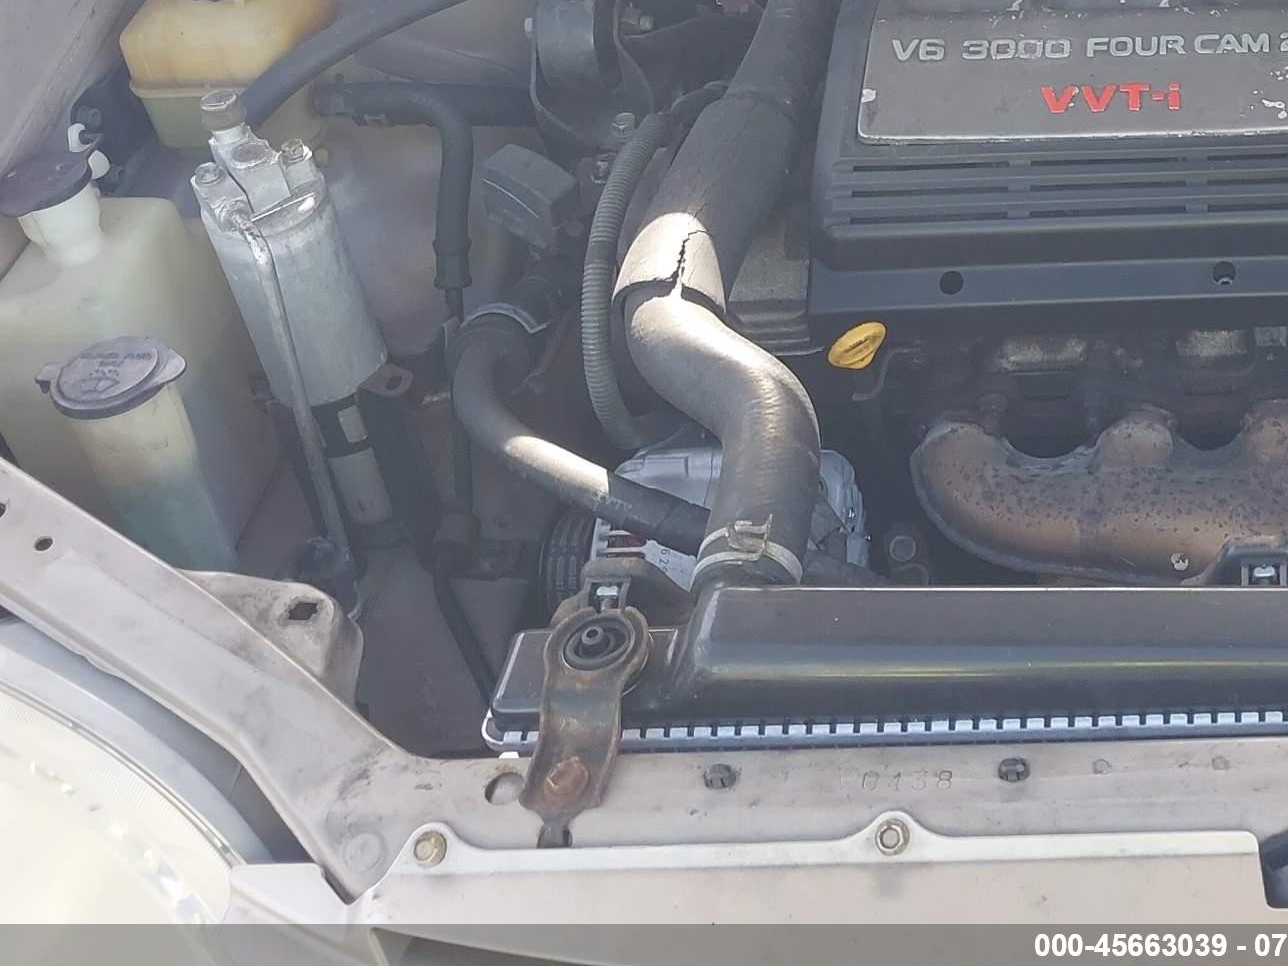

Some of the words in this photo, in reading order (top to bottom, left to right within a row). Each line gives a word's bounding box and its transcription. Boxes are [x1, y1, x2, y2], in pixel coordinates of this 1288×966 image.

[891, 38, 946, 62] V6
[961, 38, 1071, 61] 3000
[1086, 35, 1186, 57] FOUR
[1194, 32, 1270, 54] CAM
[1040, 81, 1182, 114] VVT-i
